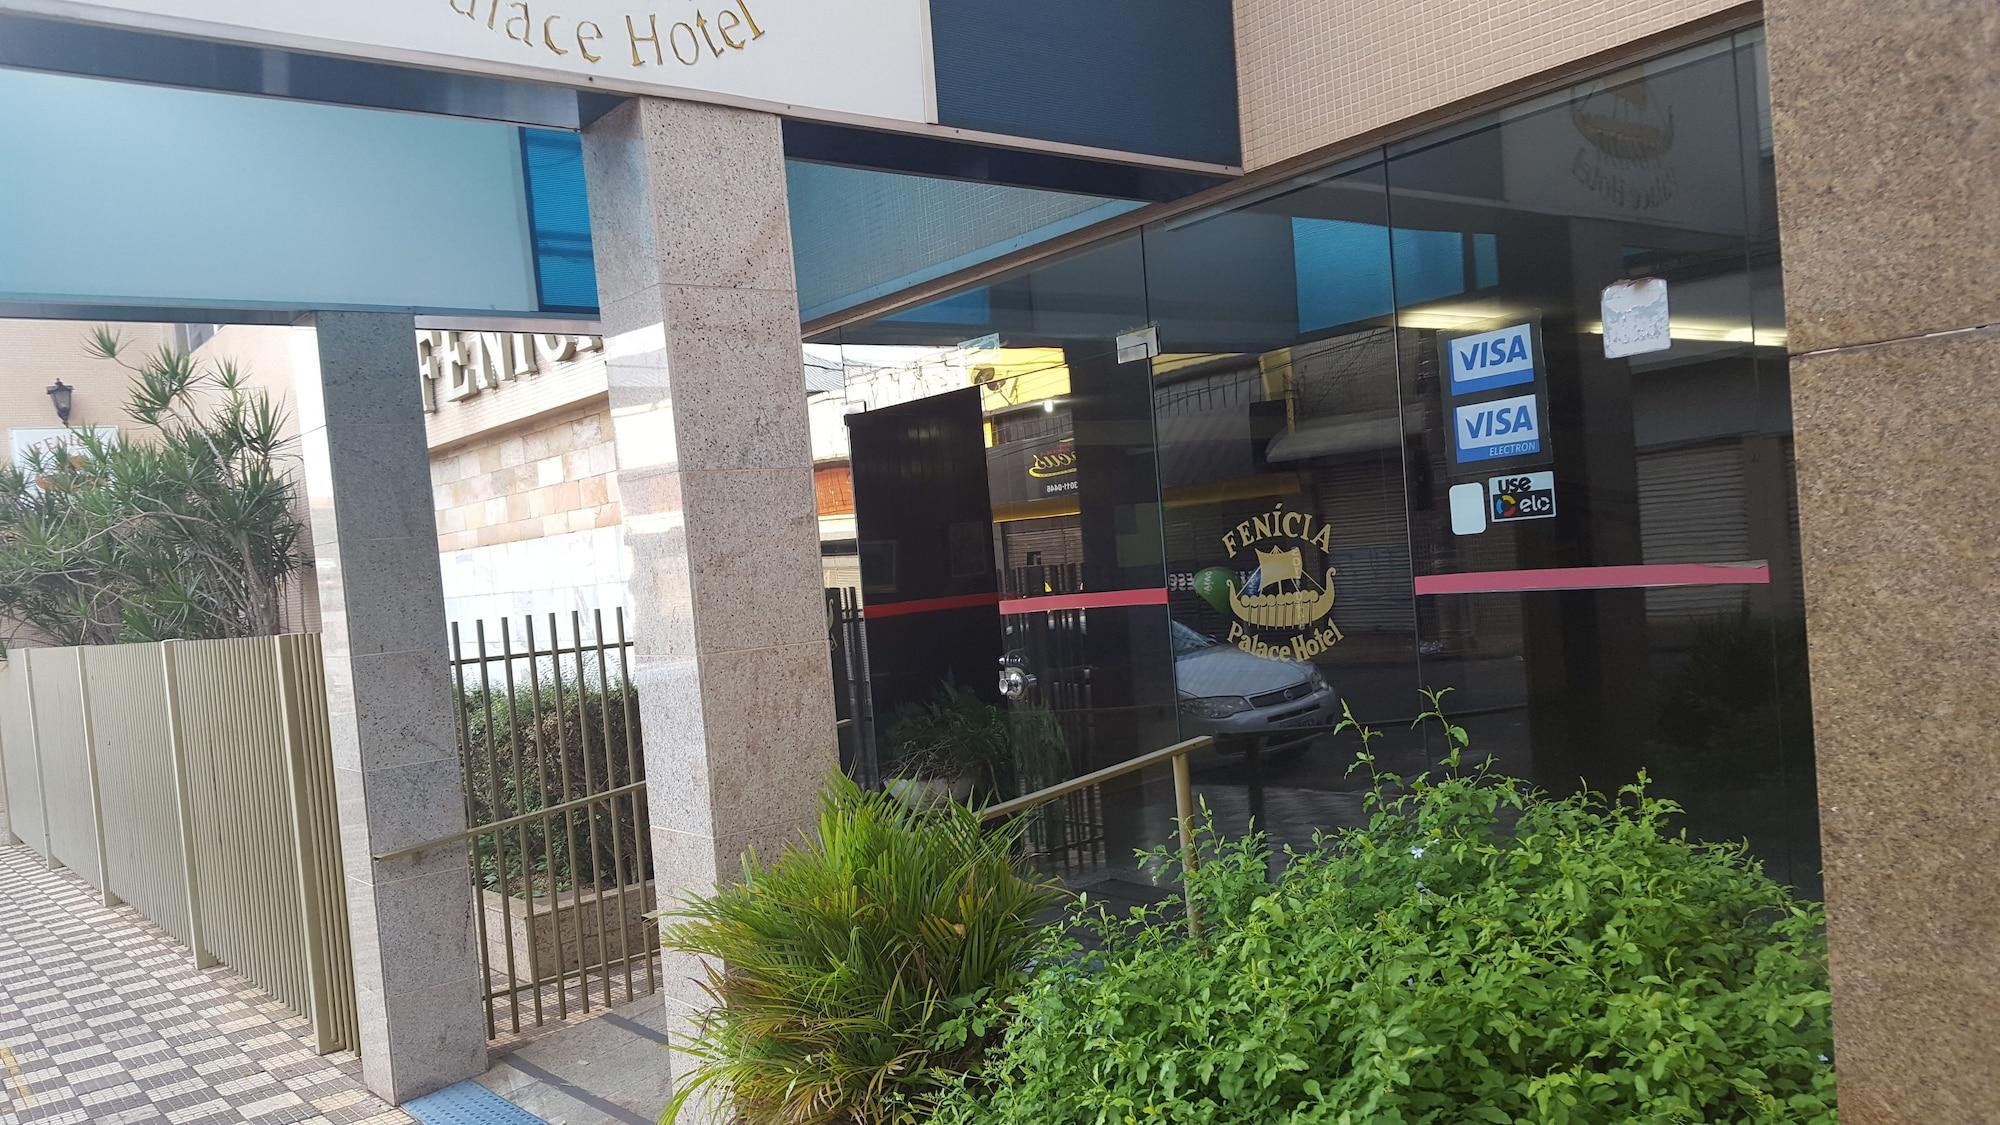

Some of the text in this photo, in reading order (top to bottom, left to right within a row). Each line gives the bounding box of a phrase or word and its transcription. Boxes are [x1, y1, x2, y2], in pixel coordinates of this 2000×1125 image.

[625, 0, 766, 66] Hotel
[1460, 335, 1528, 371] VISA
[1465, 405, 1533, 439] VISA
[1489, 442, 1536, 457] ELECTRON
[1498, 477, 1532, 494] use
[1519, 495, 1551, 513] elo
[1222, 503, 1331, 558] FENÍCIA
[1227, 617, 1344, 663] Palace Hotel
